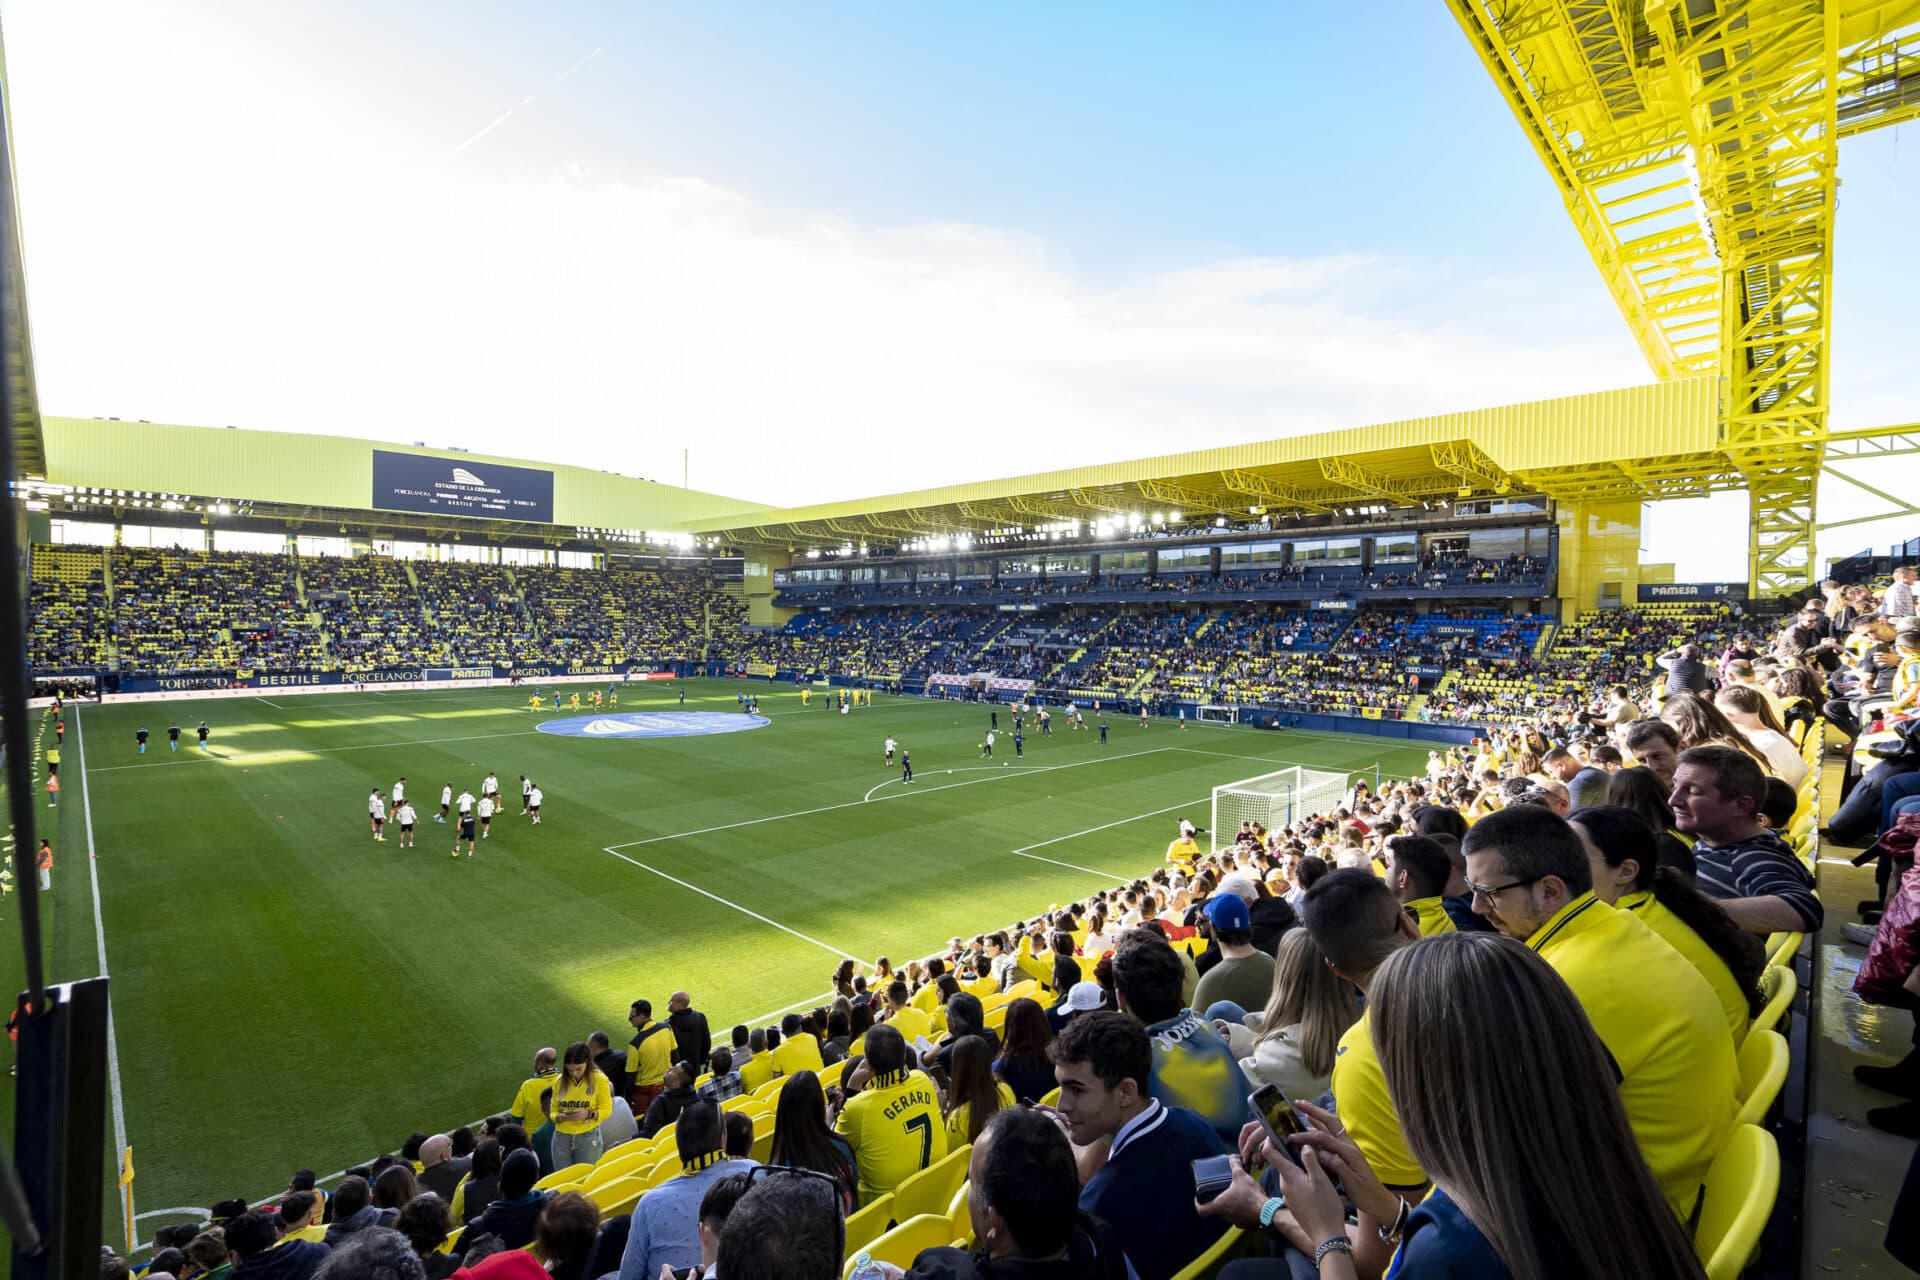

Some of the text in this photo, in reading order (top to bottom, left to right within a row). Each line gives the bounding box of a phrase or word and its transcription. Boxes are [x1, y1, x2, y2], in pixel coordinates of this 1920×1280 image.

[434, 482, 458, 490] ESTADIO
[1652, 586, 1698, 595] PAMESA
[341, 671, 425, 683] PORCELANOSA
[452, 669, 491, 679] PAMESA
[260, 675, 321, 686] BESTILE
[883, 1091, 931, 1120] GERARD
[903, 1112, 932, 1171] 7
